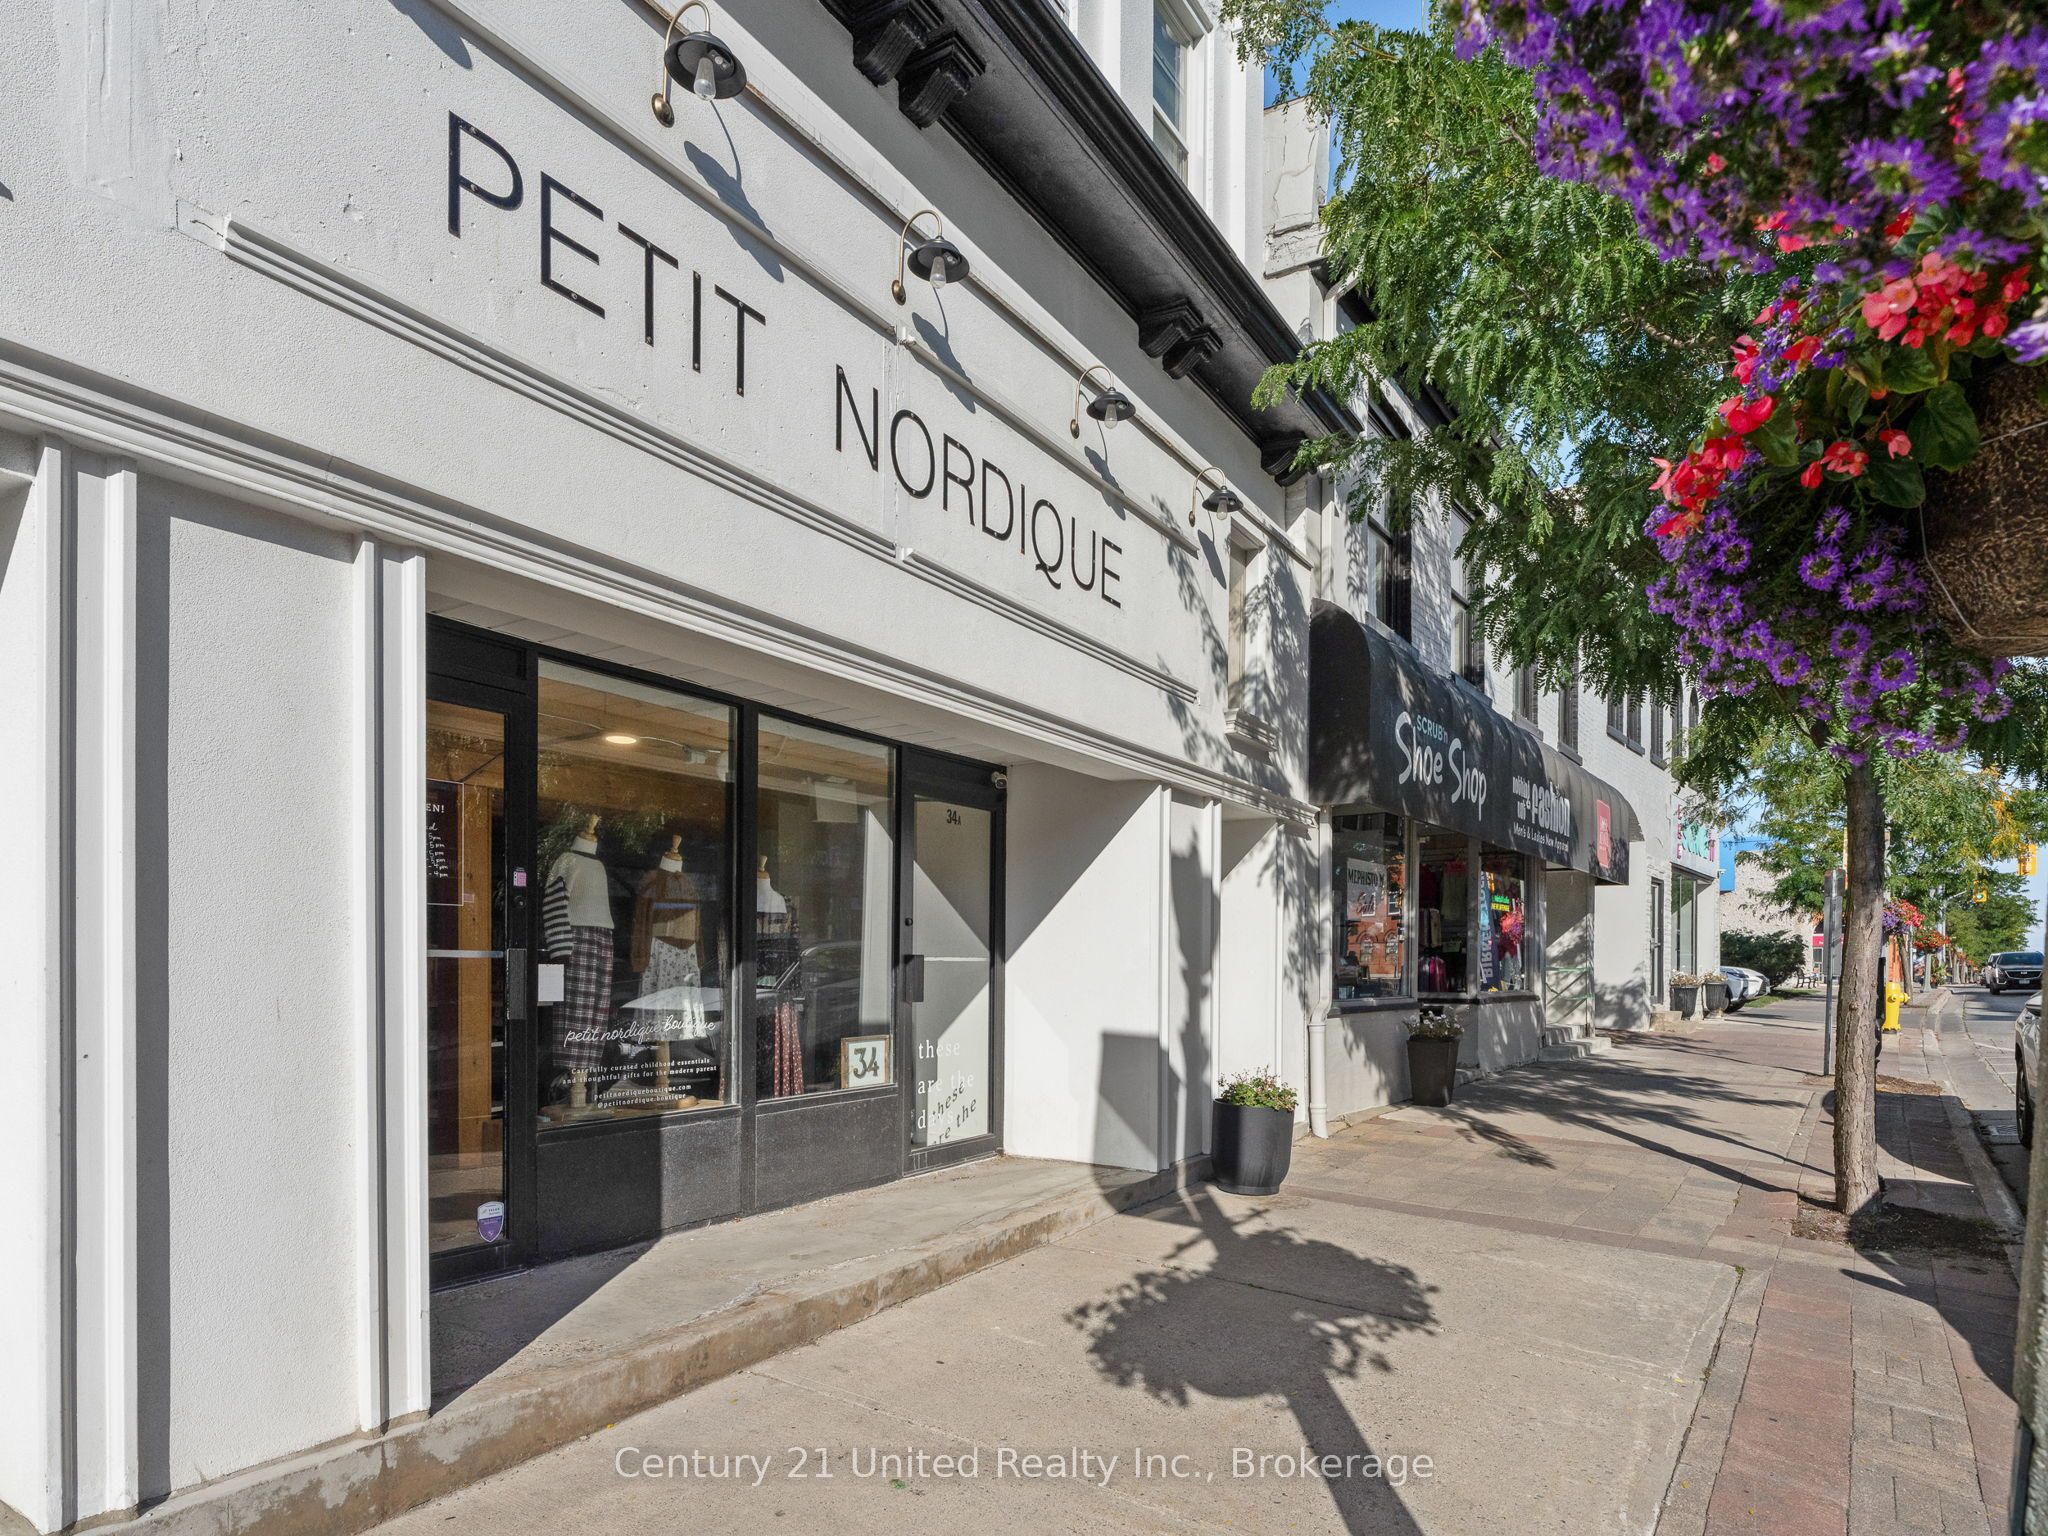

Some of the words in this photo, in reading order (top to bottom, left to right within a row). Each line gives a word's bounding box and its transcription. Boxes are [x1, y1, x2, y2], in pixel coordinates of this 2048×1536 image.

[448, 111, 766, 398] PETIT
[835, 364, 1123, 609] NORDIQUE
[1395, 711, 1443, 786] Shoe
[1448, 737, 1487, 822] Shop
[1348, 868, 1379, 887] MEPHISTO
[563, 1025, 599, 1047] petit
[600, 1021, 661, 1043] nordique
[918, 1039, 960, 1059] these
[571, 1064, 608, 1075] Carefully
[610, 1063, 638, 1072] curated
[640, 1059, 675, 1069] childhood
[677, 1057, 711, 1066] essentials
[623, 1072, 640, 1081] gifts
[642, 1070, 654, 1078] for
[669, 1067, 694, 1075] modern
[696, 1065, 717, 1074] parent
[853, 1047, 880, 1079] 34
[918, 1079, 943, 1094] are
[950, 1069, 975, 1088] the
